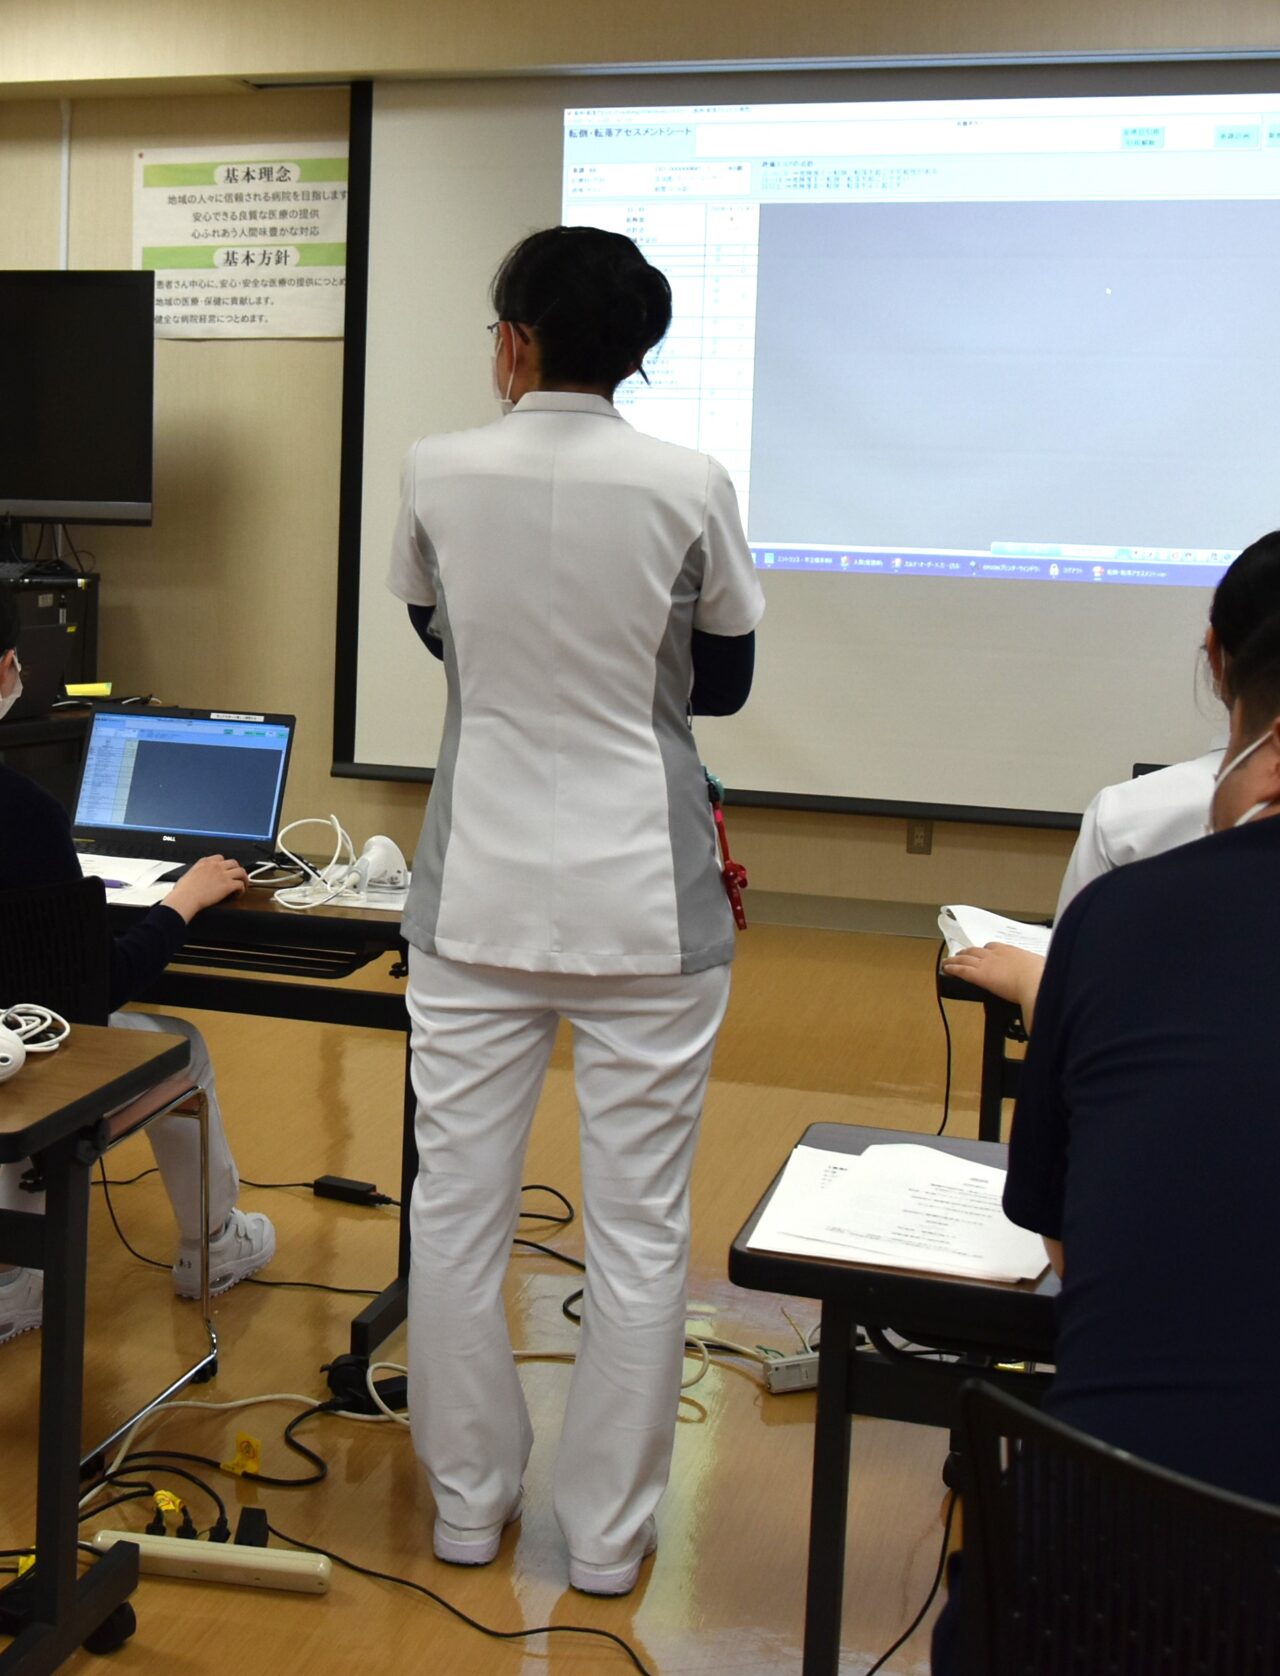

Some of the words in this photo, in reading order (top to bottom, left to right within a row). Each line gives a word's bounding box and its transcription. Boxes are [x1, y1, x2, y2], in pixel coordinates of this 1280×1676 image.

[224, 166, 291, 183] 基本理念
[193, 208, 320, 222] 安心できる良質な医療の提供
[192, 226, 320, 239] 心ふれあう人間味豊かな対応
[223, 249, 291, 267] 基本方針
